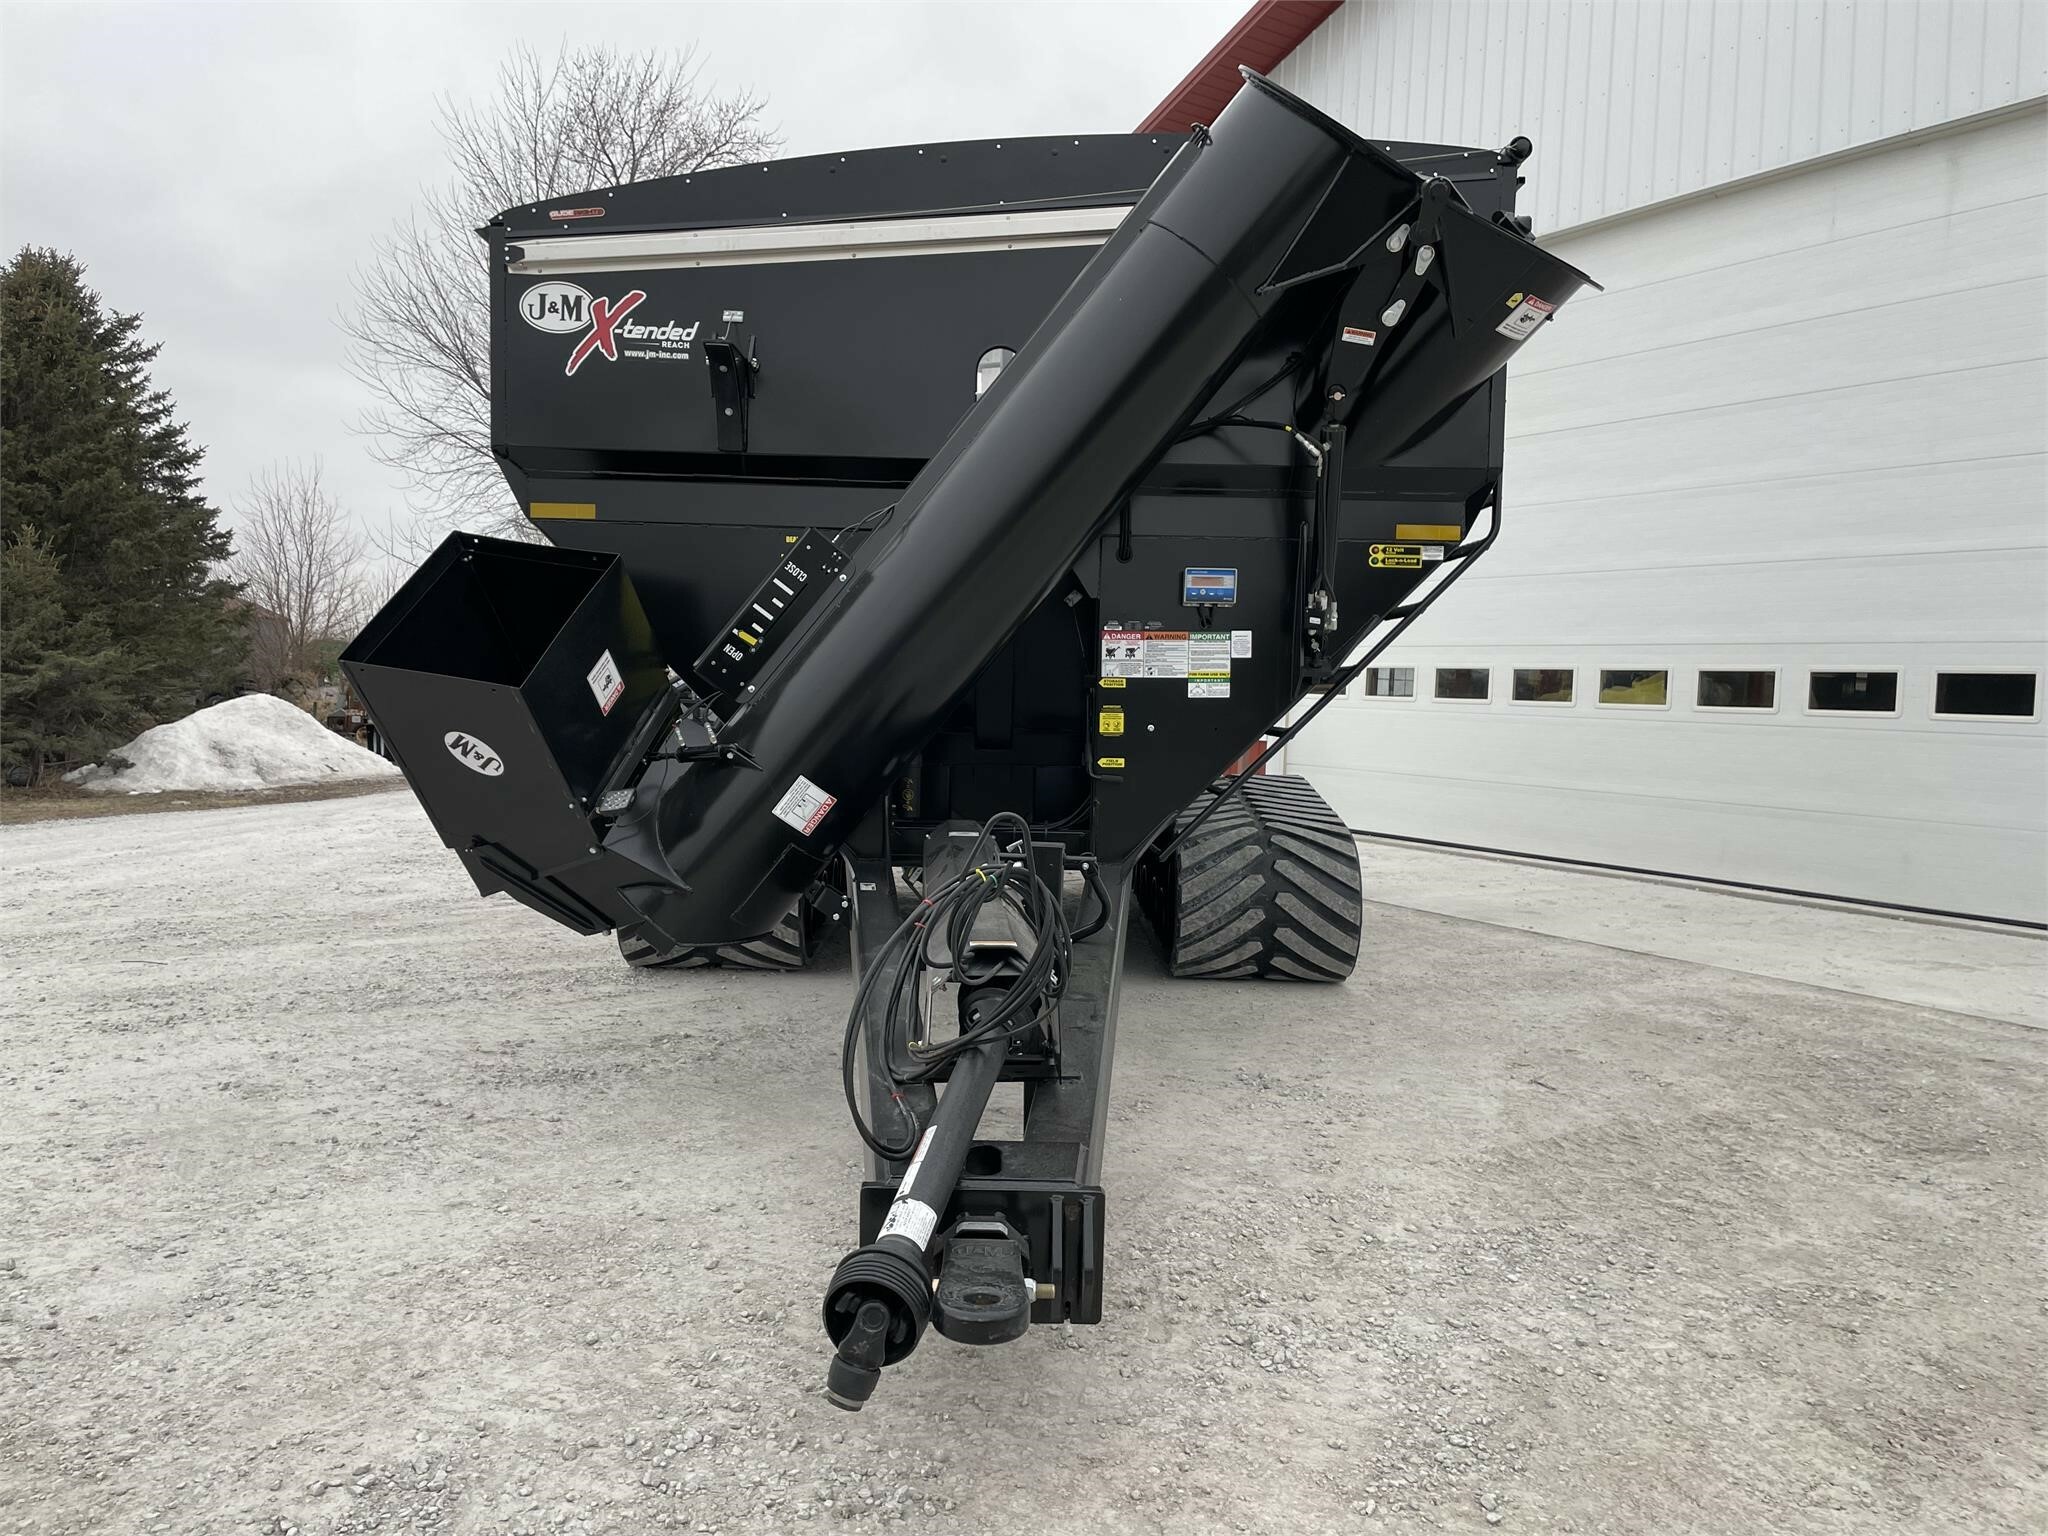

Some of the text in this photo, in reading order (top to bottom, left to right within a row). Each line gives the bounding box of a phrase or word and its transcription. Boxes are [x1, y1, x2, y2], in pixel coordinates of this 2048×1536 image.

[527, 293, 584, 323] J&M
[624, 350, 689, 360] www.jm-inc.com
[661, 341, 690, 349] REACH
[784, 561, 807, 582] CLOSE
[723, 643, 743, 661] OPEN
[448, 734, 501, 773] J&M
[803, 804, 829, 833] DANGER
